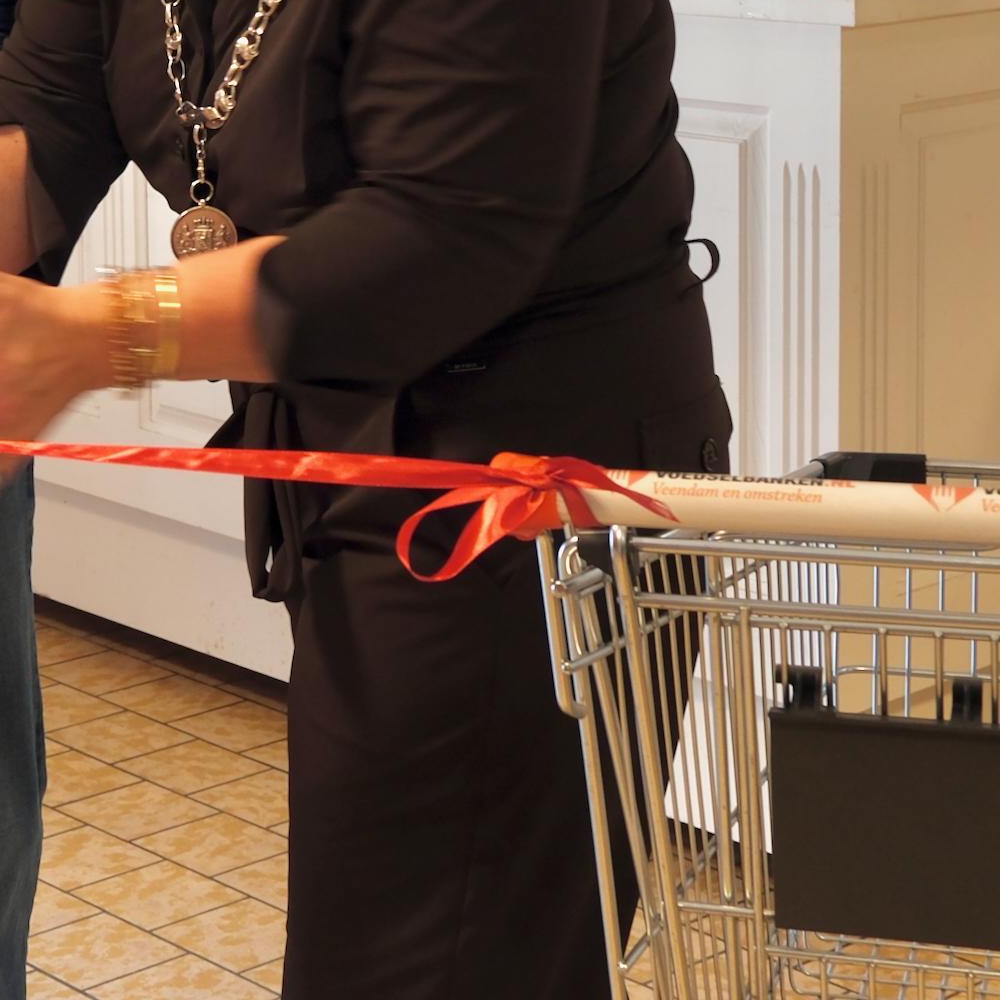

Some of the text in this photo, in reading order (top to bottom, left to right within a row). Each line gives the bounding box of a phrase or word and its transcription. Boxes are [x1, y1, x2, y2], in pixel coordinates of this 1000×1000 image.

[653, 482, 823, 504] Veendam en omstreken
